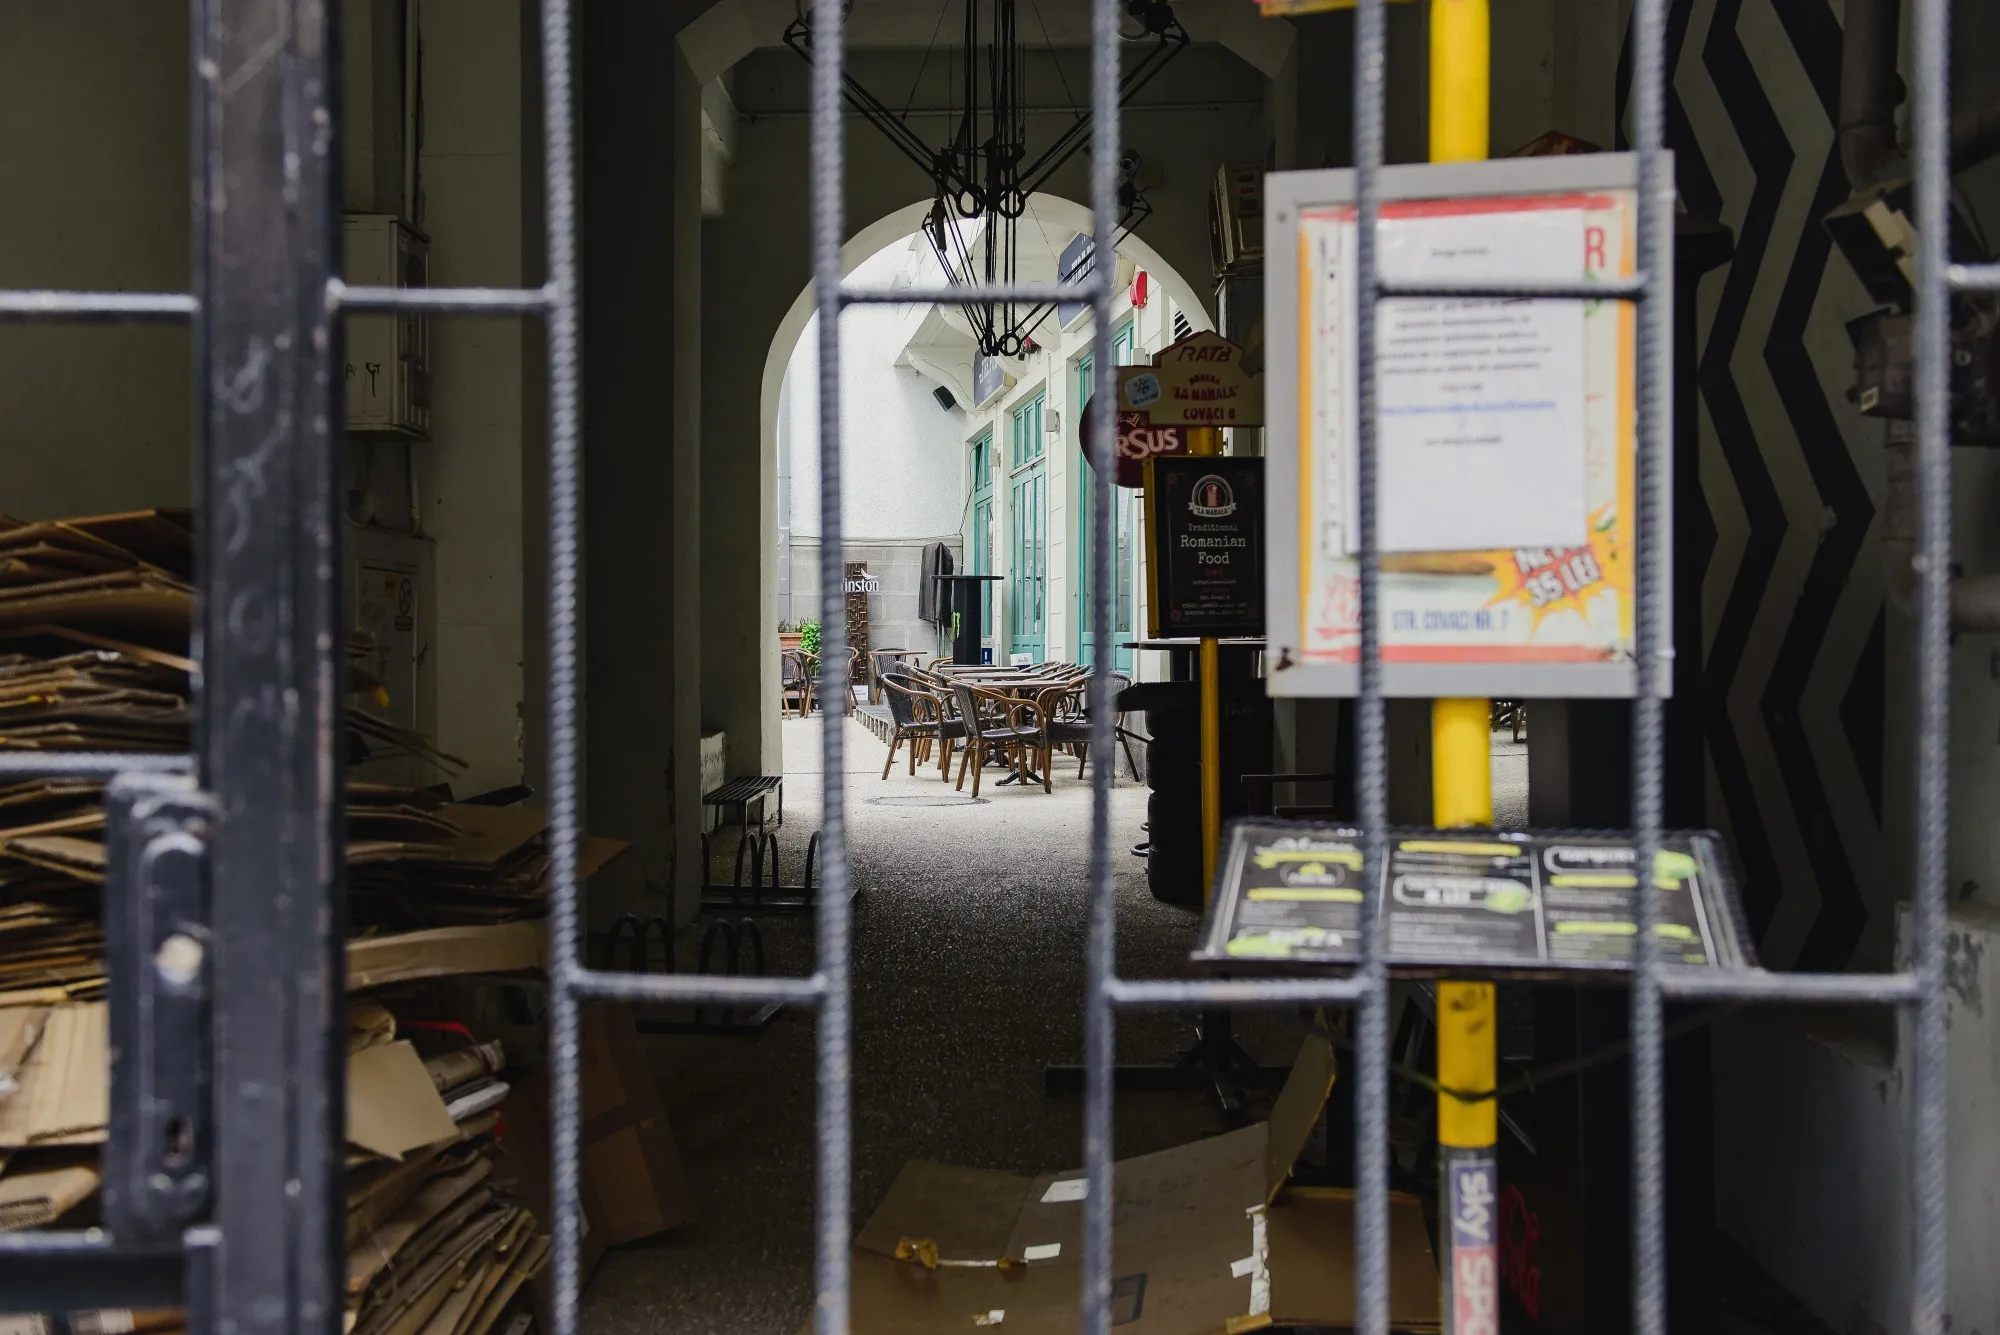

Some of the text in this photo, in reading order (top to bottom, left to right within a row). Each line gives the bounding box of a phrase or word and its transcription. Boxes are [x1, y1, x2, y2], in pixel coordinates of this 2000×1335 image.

[1177, 345, 1232, 362] RATB
[1183, 407, 1236, 420] COVACI 8
[1187, 523, 1238, 531] Traditional
[1180, 535, 1246, 548] Romanian
[1197, 552, 1230, 565] Food
[841, 578, 879, 592] inston
